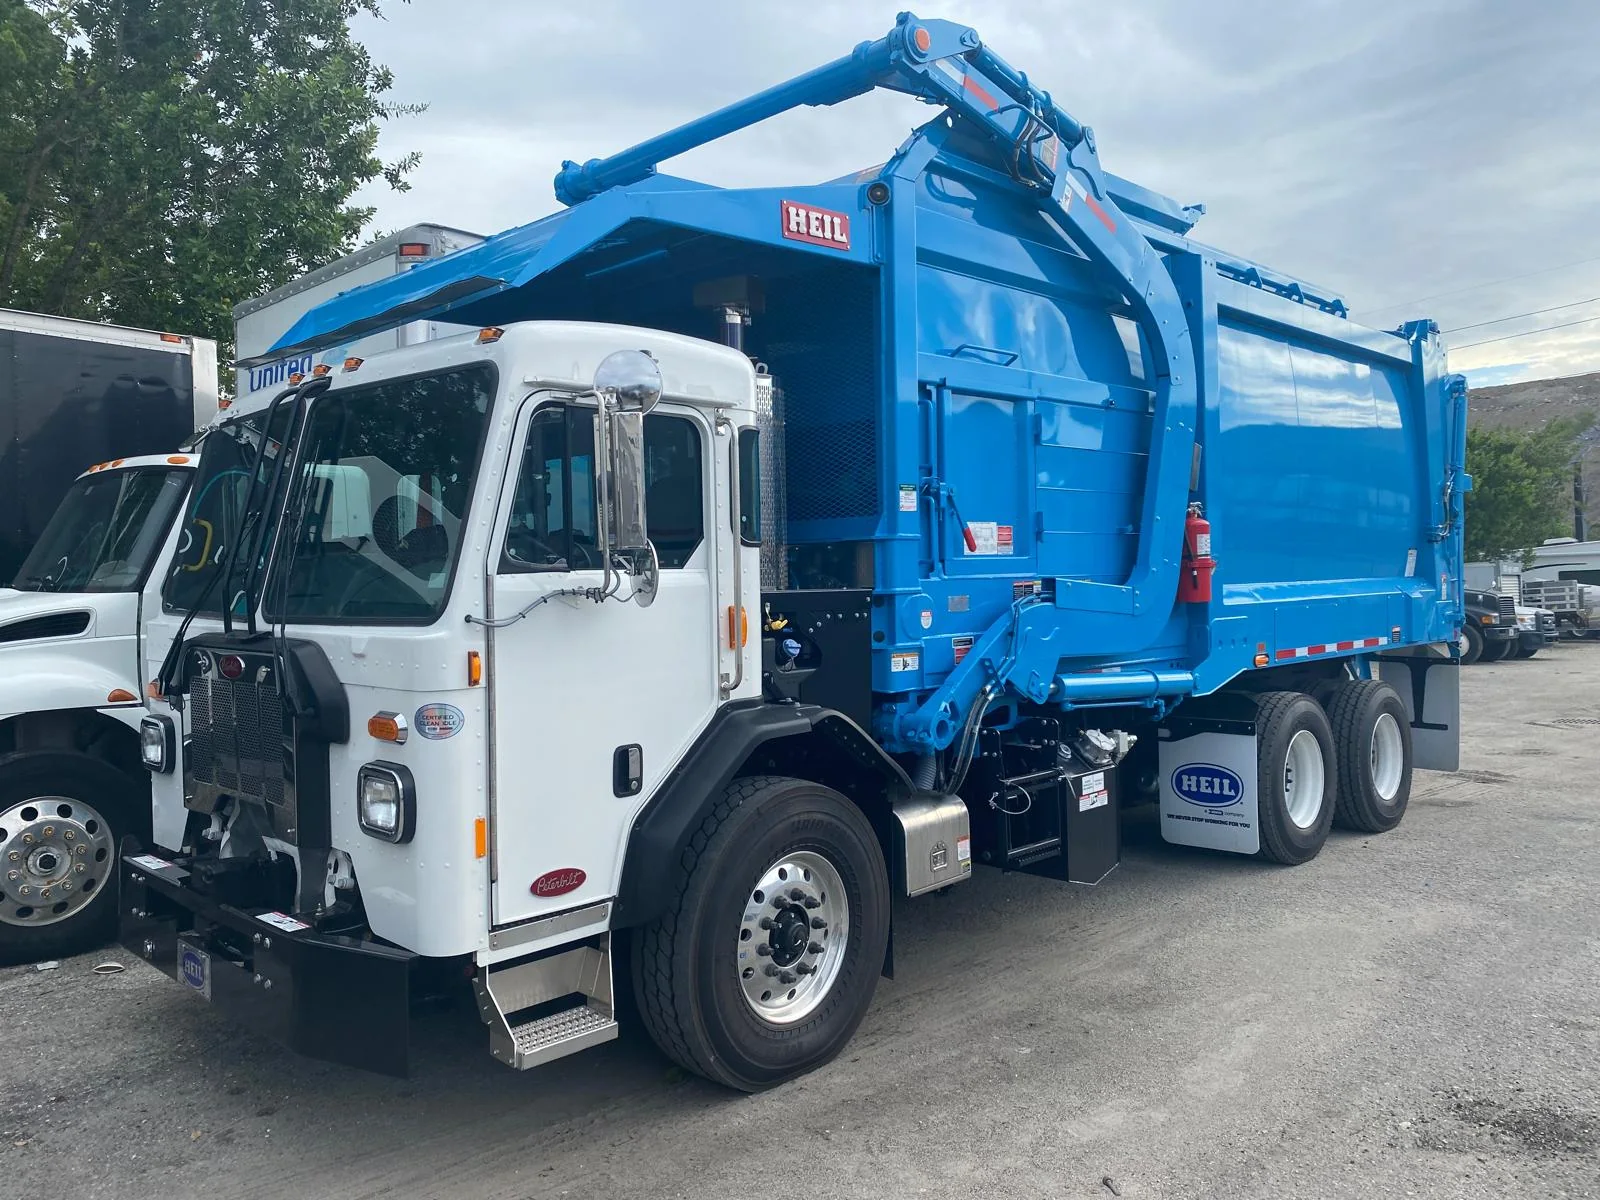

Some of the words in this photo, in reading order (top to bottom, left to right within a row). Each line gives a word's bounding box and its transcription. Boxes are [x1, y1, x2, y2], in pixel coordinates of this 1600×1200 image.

[788, 206, 848, 243] HEIL
[1181, 774, 1236, 796] HEIL
[537, 871, 582, 894] Peterbilt
[185, 959, 203, 981] HEIL
